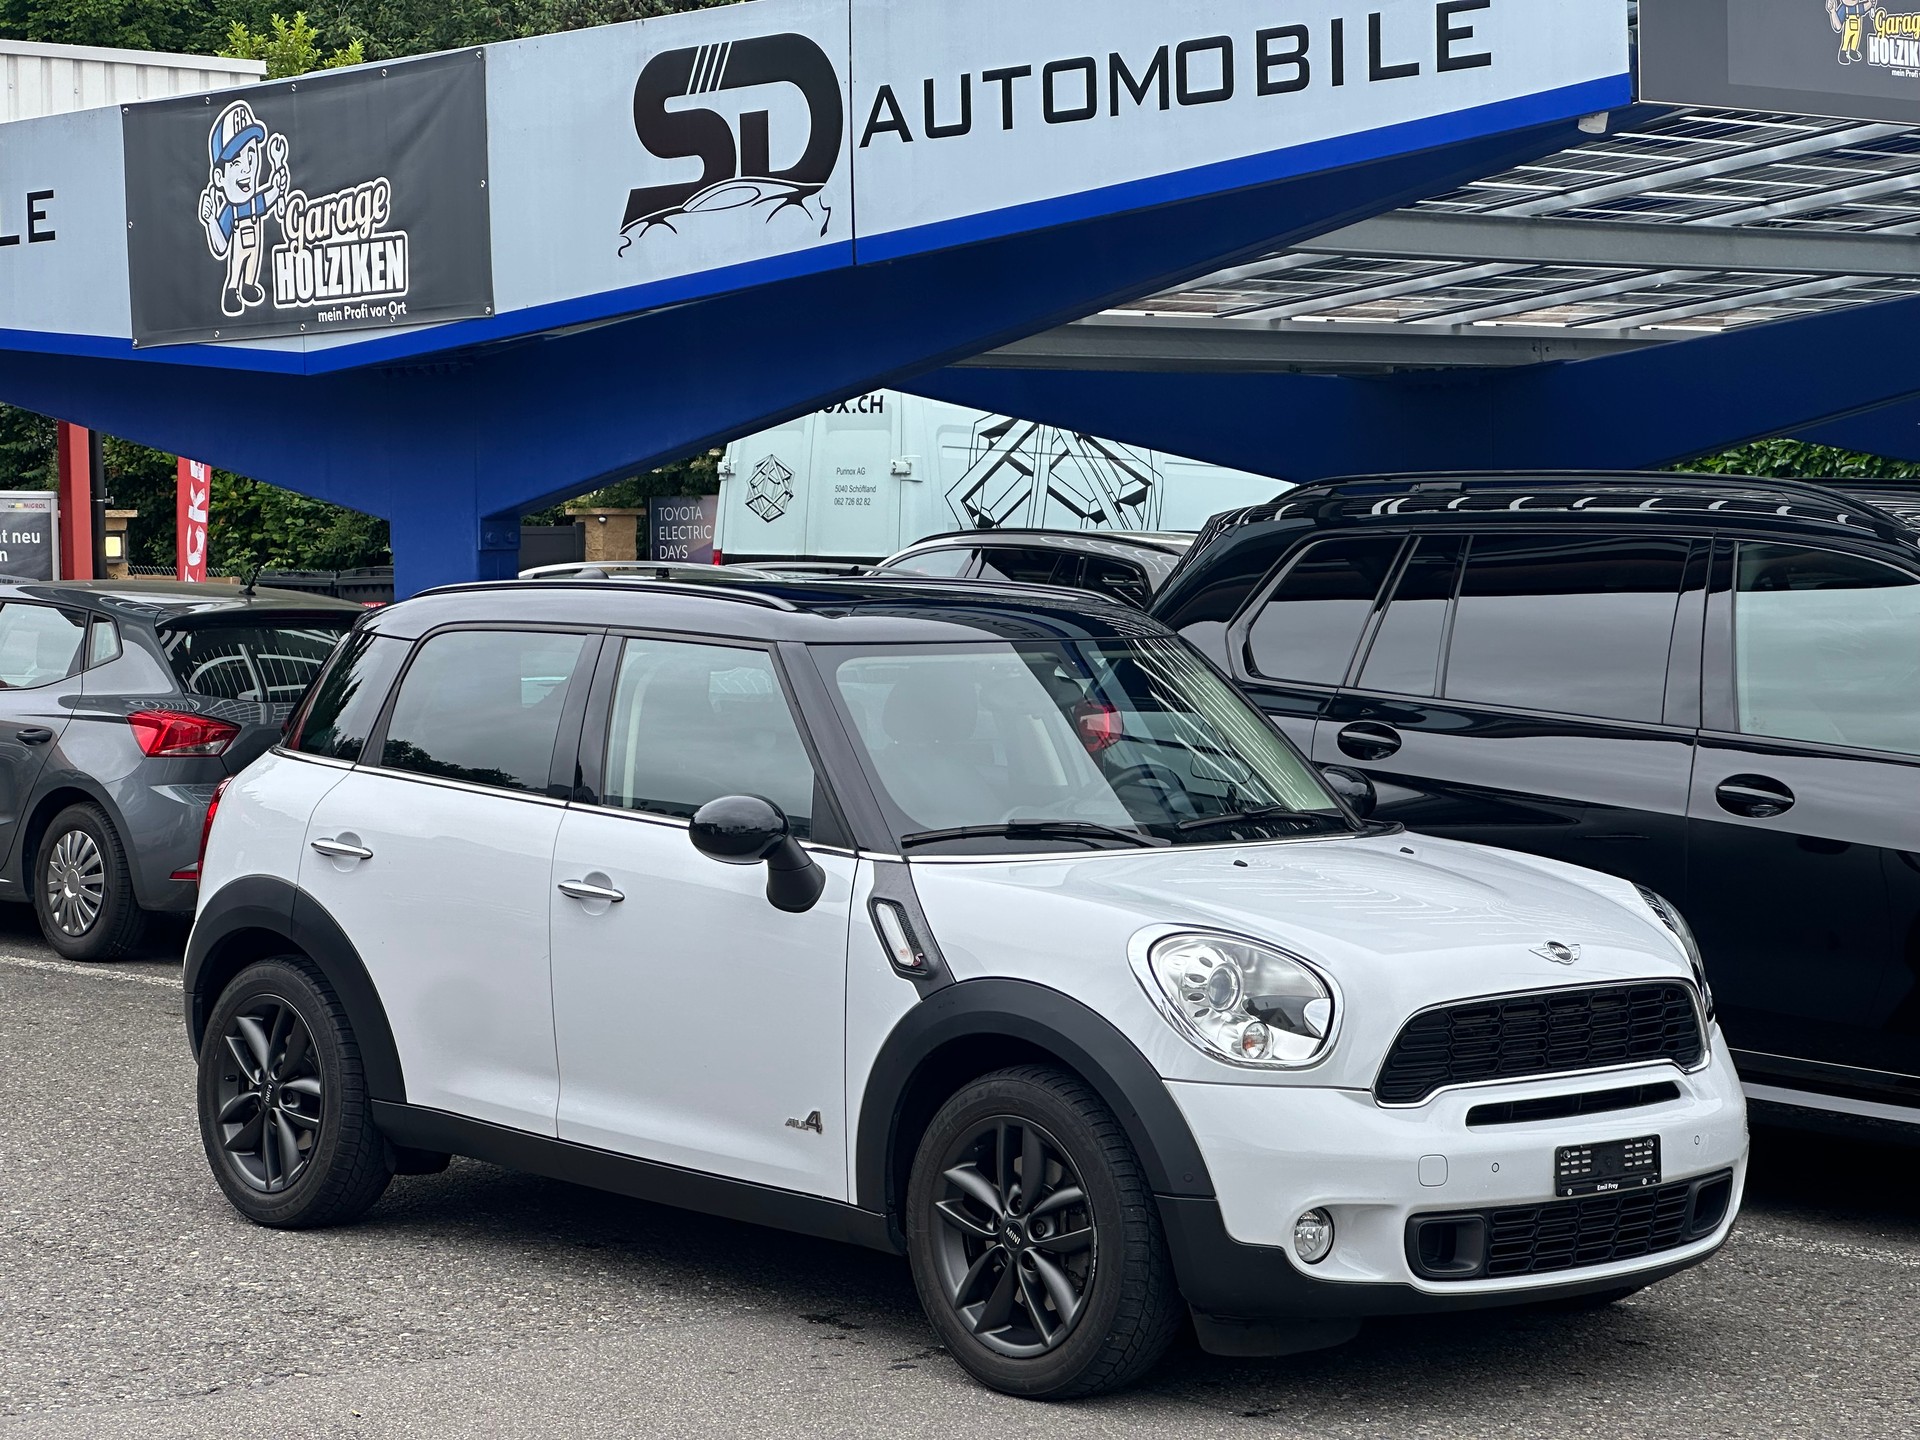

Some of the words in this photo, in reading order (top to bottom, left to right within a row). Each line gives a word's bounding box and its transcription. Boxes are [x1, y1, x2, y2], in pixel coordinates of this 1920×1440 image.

[620, 32, 844, 232] SD
[858, 0, 1493, 149] AUTOMOBILE
[285, 184, 388, 257] Garage
[275, 239, 406, 301] HOLZIKEN
[317, 307, 343, 322] mein
[343, 303, 369, 320] Profi
[370, 305, 387, 317] vor
[388, 300, 407, 316] Ort
[857, 467, 866, 475] AG
[834, 498, 844, 506] 062
[856, 498, 863, 506] 82
[864, 498, 871, 506] 82
[658, 506, 703, 521] TOYOTA
[12, 532, 41, 544] neu
[659, 524, 712, 541] ELECTRIC
[660, 544, 688, 560] DAYS
[1596, 1183, 1608, 1191] Emil
[1608, 1182, 1619, 1190] Frey
[1005, 1227, 1021, 1245] MINI
